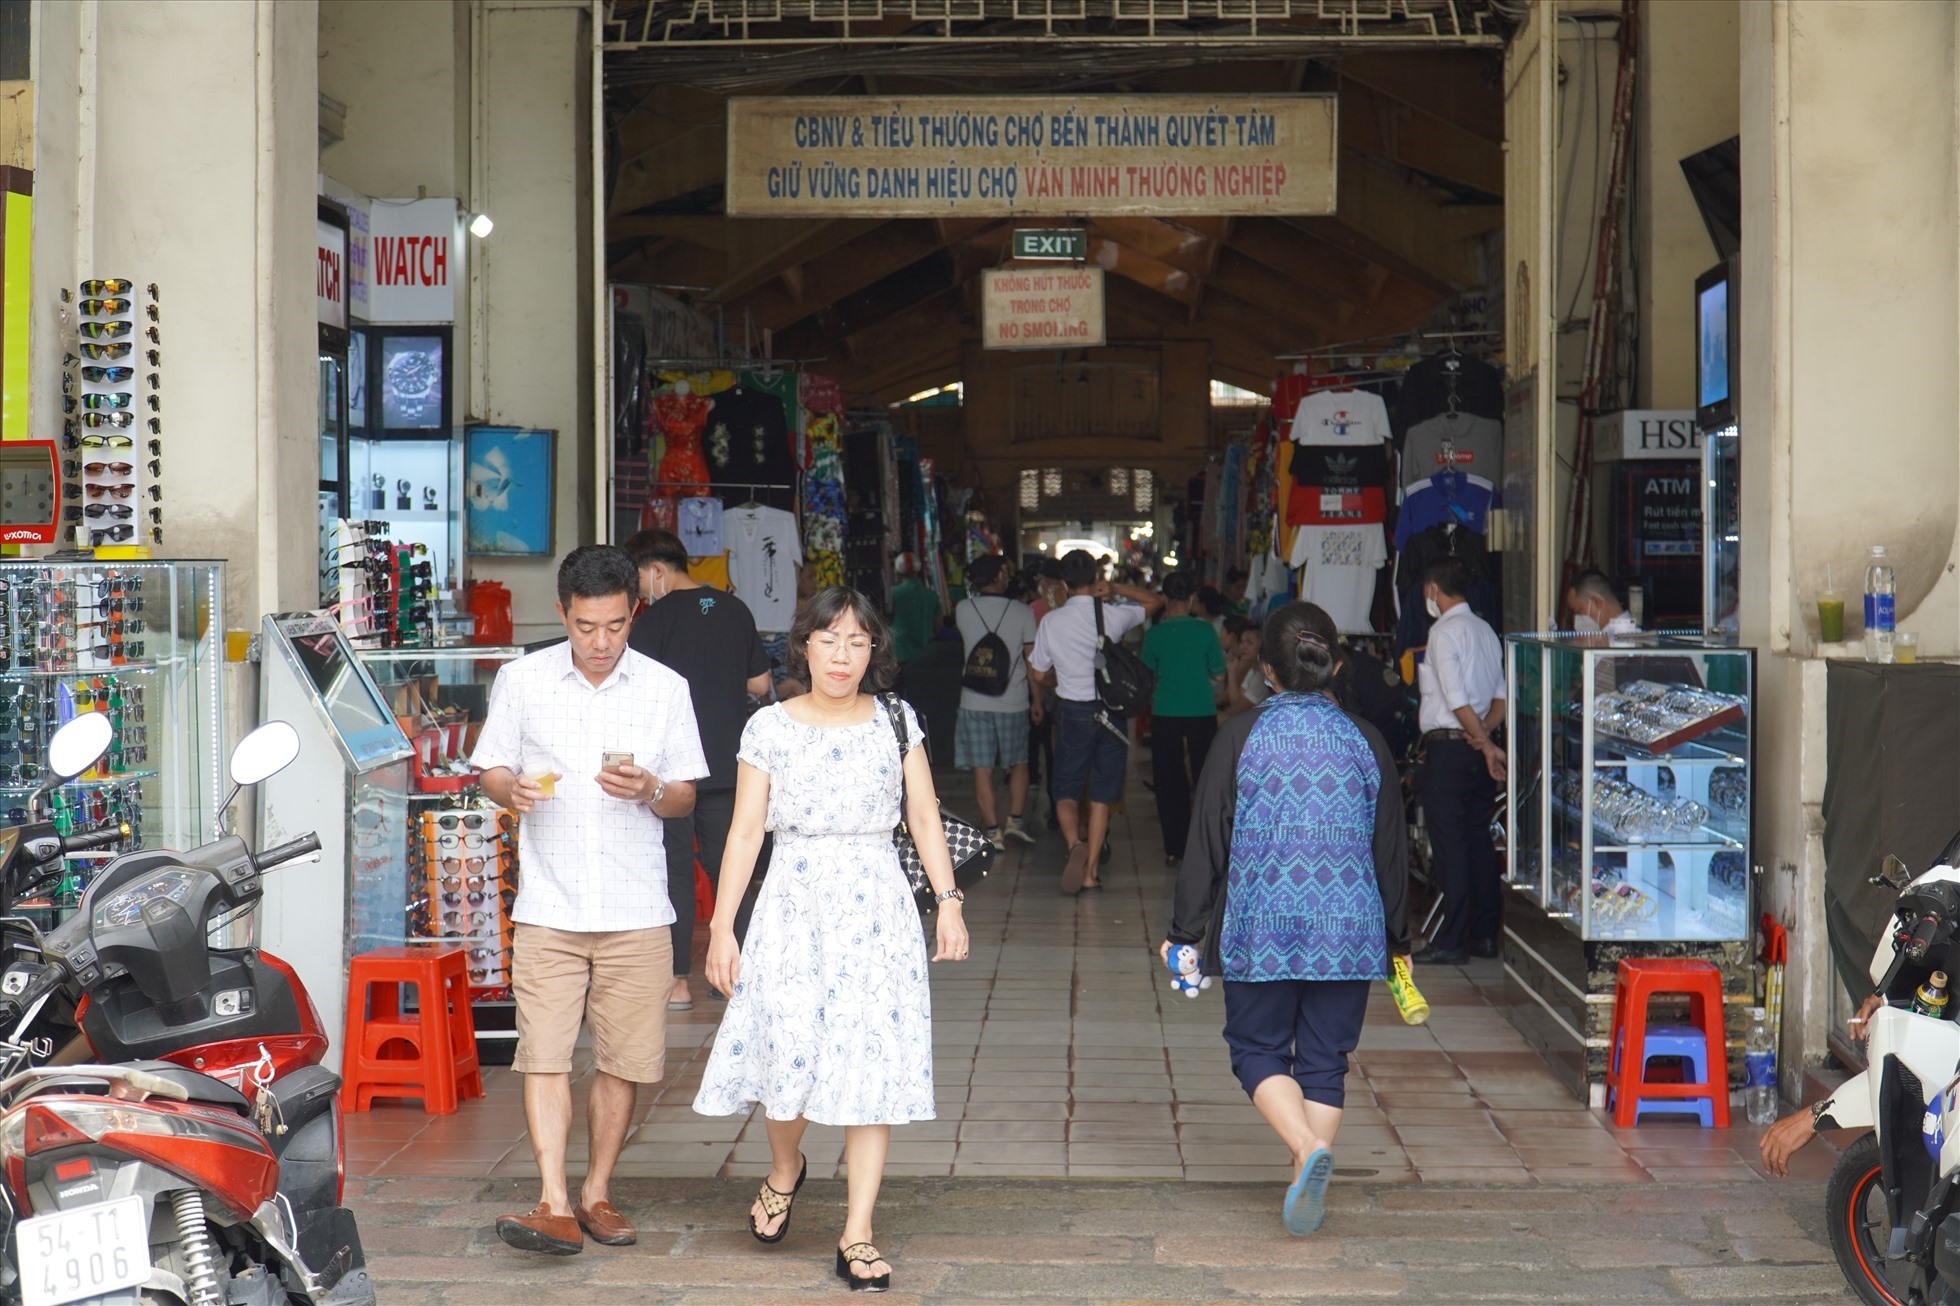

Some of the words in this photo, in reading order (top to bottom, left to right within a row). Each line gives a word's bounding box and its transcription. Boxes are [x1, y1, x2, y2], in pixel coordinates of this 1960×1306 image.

[795, 115, 847, 147] CBNV
[851, 116, 864, 147] &
[871, 103, 914, 148] TIỂU
[919, 109, 999, 148] THƯƠNG
[1005, 109, 1044, 156] CHỢ
[1051, 105, 1088, 147] BẾN
[1095, 107, 1160, 147] THÀNH
[1166, 105, 1229, 148] QUYẾT
[1235, 108, 1276, 147] TÂM
[768, 160, 802, 199] GIỮ
[808, 160, 861, 199] VỮNG
[867, 167, 920, 198] DANH
[926, 160, 972, 207] HIỆU
[978, 161, 1018, 206] CHỢ
[1024, 159, 1064, 198] VĂN
[1070, 165, 1120, 197] MINH
[1126, 160, 1207, 198] THƯƠNG
[1213, 158, 1287, 205] NGHIỆP
[1023, 235, 1078, 253] EXIT
[374, 235, 447, 287] WATCH
[993, 274, 1031, 293] KHÔNG
[1034, 273, 1054, 291] HÚT
[1010, 298, 1046, 315] TRONG
[1048, 295, 1072, 317] CHỢ
[998, 322, 1019, 339] NO
[1324, 487, 1360, 495] TOMMY
[1645, 478, 1691, 495] ATM
[1322, 510, 1362, 518] JEANS
[59, 1183, 99, 1199] HONDA
[37, 1207, 120, 1258] 54-T1
[43, 1246, 129, 1296] 4906
